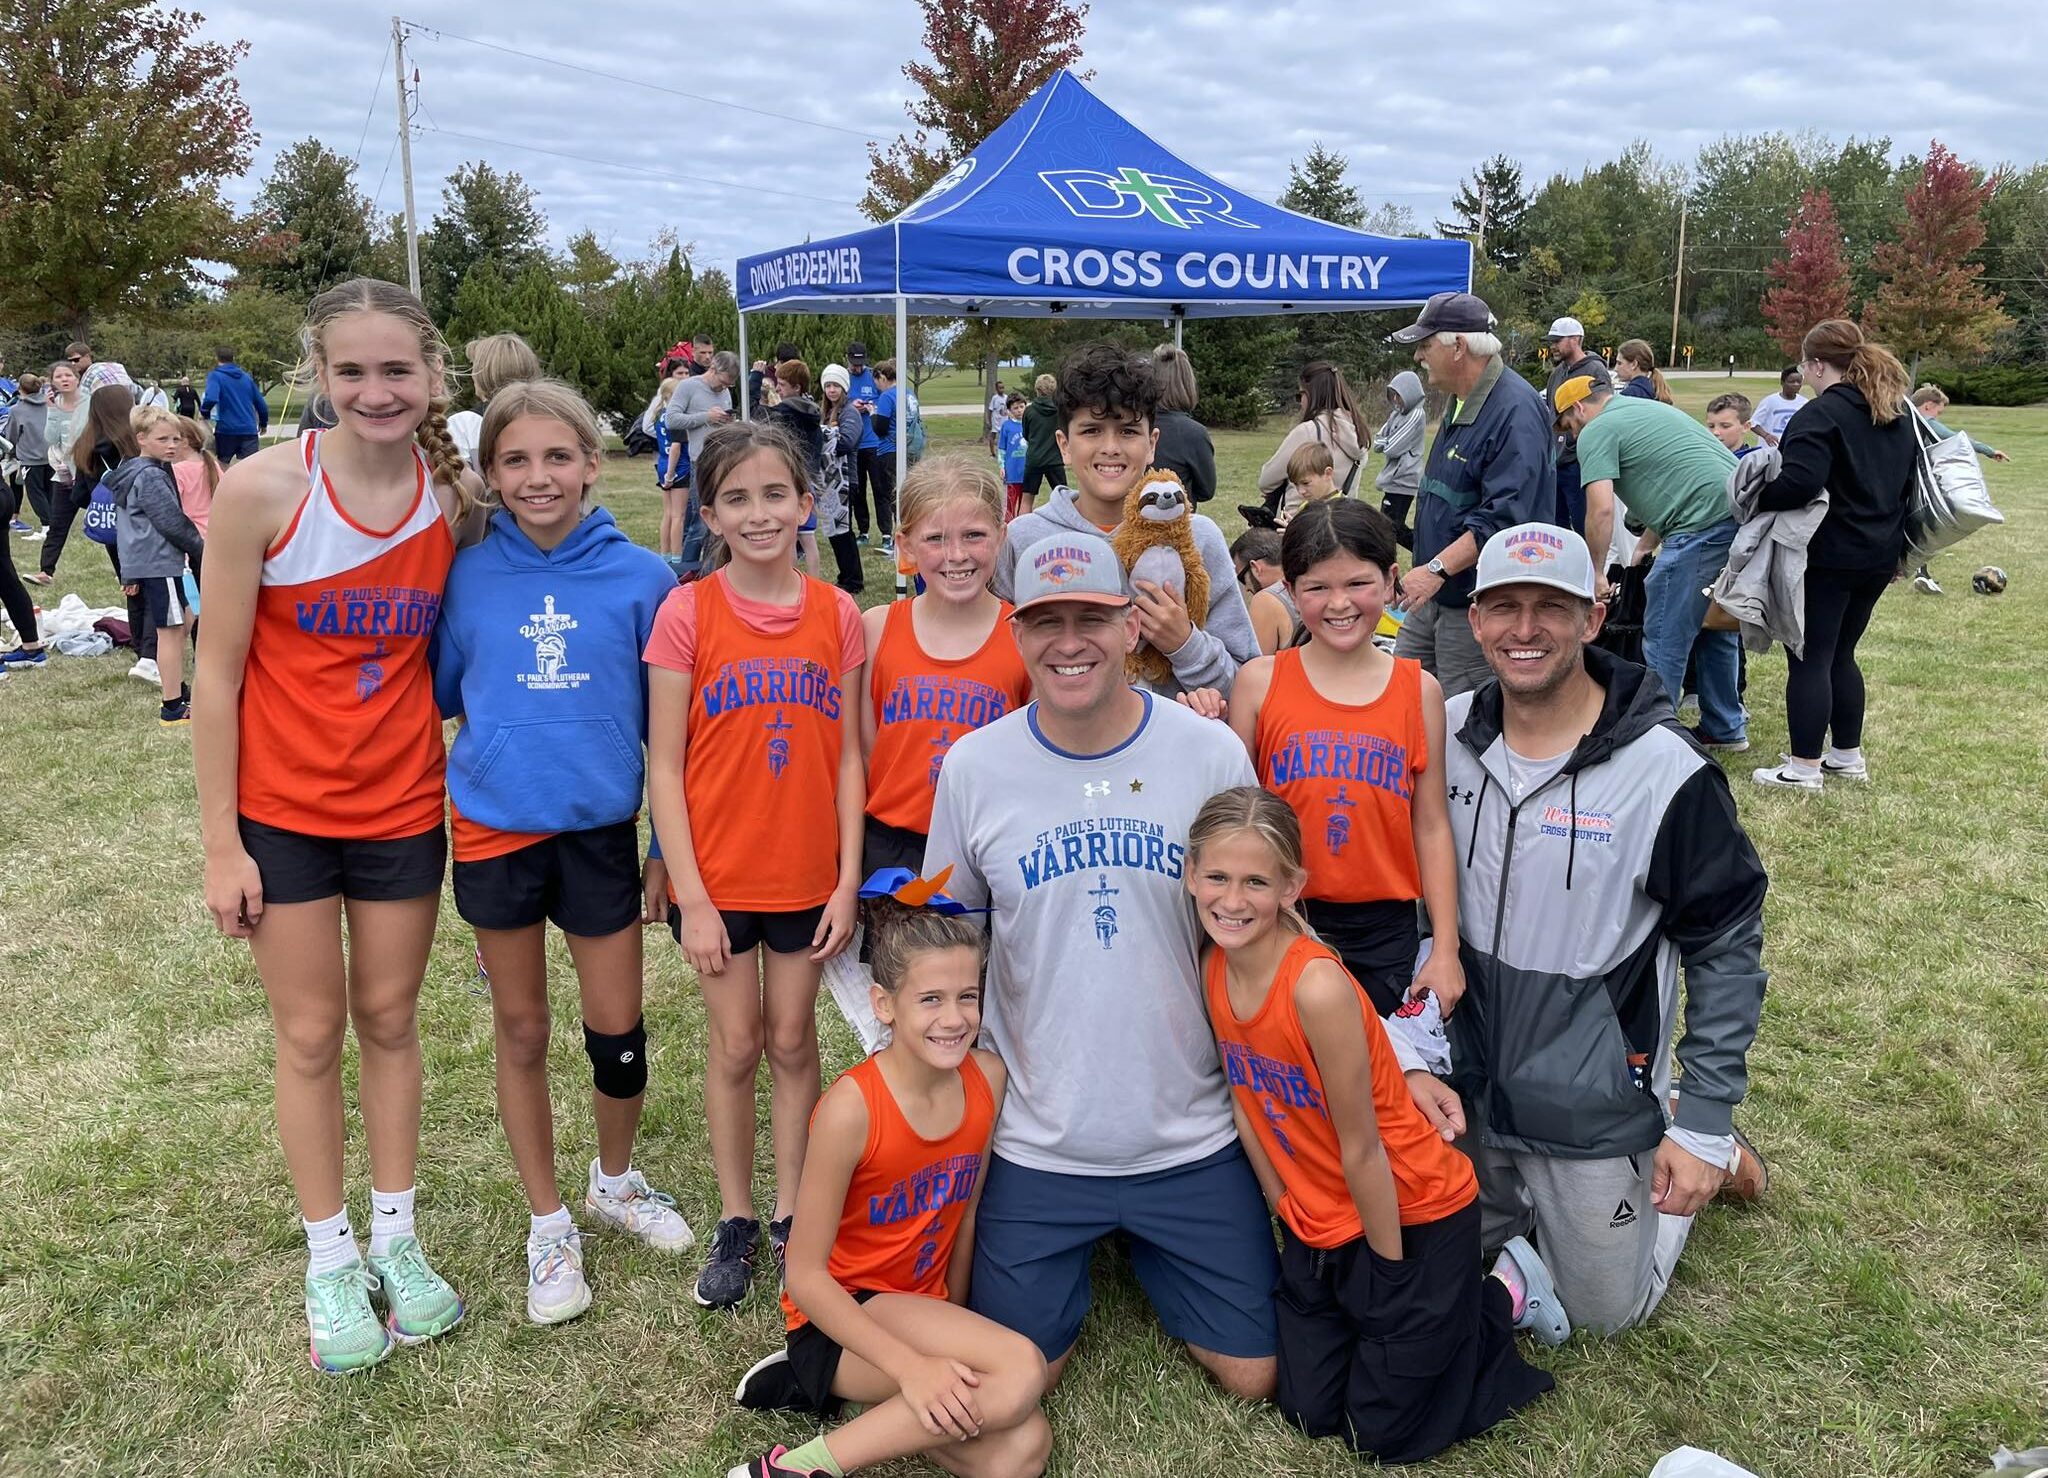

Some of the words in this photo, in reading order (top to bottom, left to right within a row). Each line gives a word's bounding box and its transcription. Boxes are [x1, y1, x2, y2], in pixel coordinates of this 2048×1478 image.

[750, 257, 785, 297] DIVINE
[785, 247, 862, 287] REDEEMER
[1007, 247, 1162, 288] CROSS
[1175, 252, 1389, 290] COUNTRY
[1504, 531, 1563, 550] WARRIORS
[1034, 547, 1092, 569] WARRIORS
[343, 586, 382, 600] PAUL'S
[296, 600, 438, 638] WARRIOR
[527, 673, 549, 682] PAUL'S
[557, 673, 590, 682] LUTHERAN
[738, 658, 775, 672] PAUL'S
[703, 670, 842, 720] WARRIORS
[952, 678, 1006, 704] LUTHERAN
[883, 687, 1005, 729] WARRIOR
[1305, 730, 1344, 744] PAUL'S
[1349, 731, 1406, 760] LUTHERAN
[1036, 830, 1054, 848] ST.
[1055, 819, 1094, 840] PAUL'S
[1099, 817, 1163, 838] LUTHERAN
[1540, 824, 1567, 837] CROSS
[1569, 829, 1612, 842] OUNTRY
[1018, 832, 1185, 890] WARRIORS
[1609, 1214, 1637, 1229] Reebok
